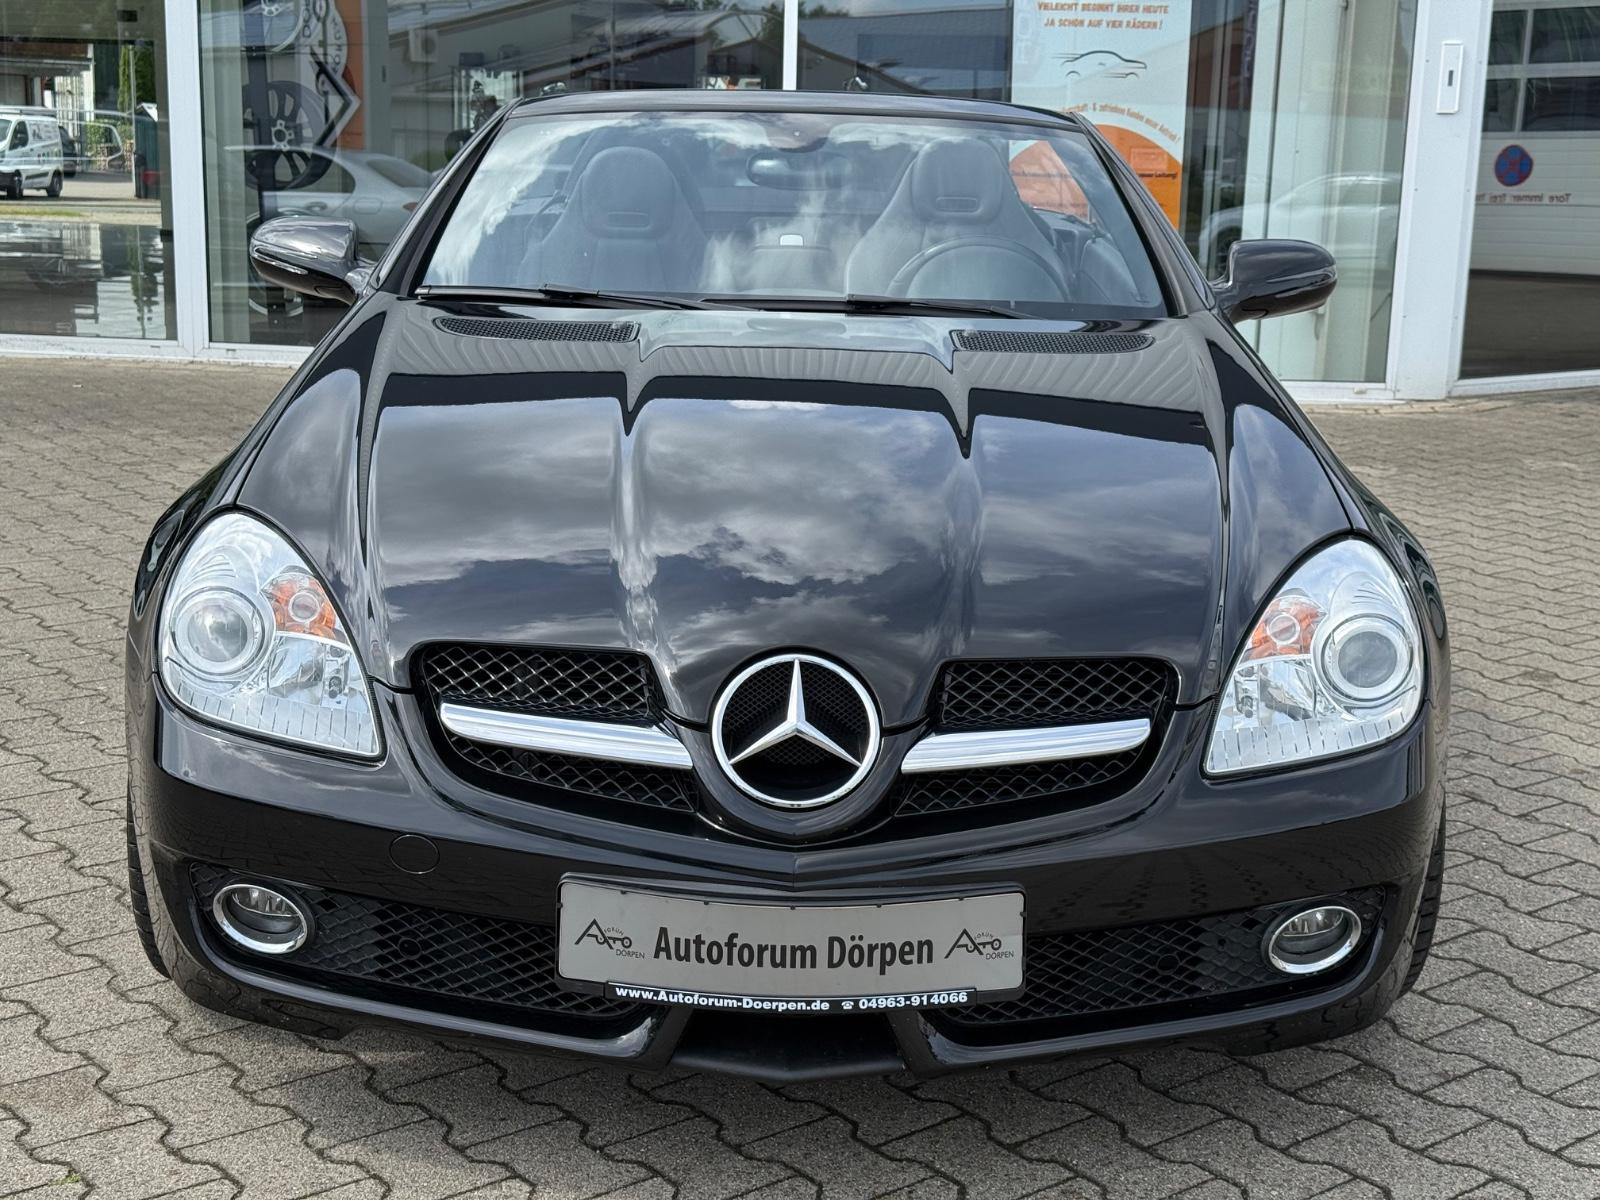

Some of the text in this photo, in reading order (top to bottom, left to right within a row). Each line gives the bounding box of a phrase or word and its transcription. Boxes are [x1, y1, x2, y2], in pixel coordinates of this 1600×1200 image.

[1142, 5, 1169, 14] HEUTE
[1044, 18, 1055, 27] JA
[1087, 18, 1103, 28] AUF
[1106, 19, 1123, 29] VIER
[653, 926, 934, 976] Autoforum Dörpen
[615, 986, 968, 1011] www.Autoforum-Doerpen.de 04963-914066
